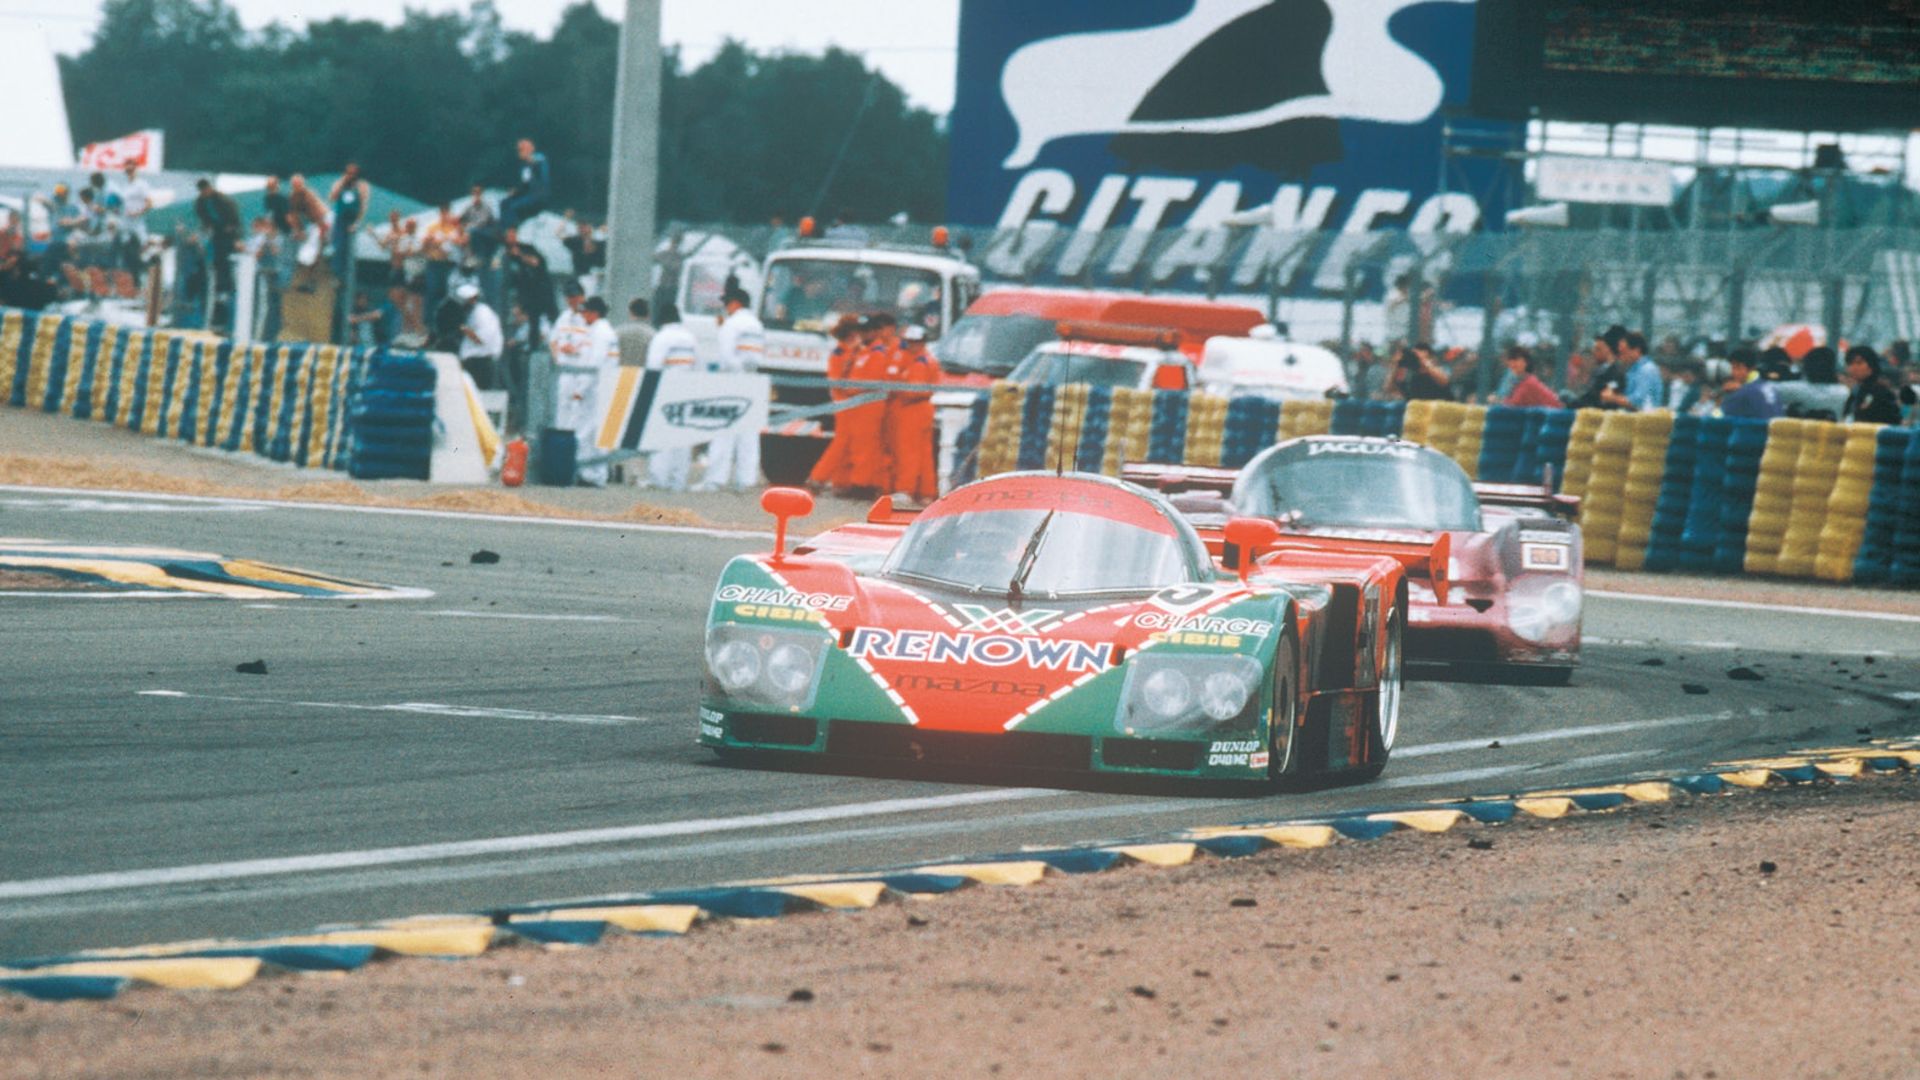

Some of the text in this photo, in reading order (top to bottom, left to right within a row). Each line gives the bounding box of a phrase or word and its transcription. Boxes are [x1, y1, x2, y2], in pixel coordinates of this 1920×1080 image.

[985, 168, 1480, 290] GITANES
[1307, 442, 1419, 460] JAGUAR
[716, 584, 855, 612] CHARGE
[1134, 611, 1274, 639] CHARGE
[848, 626, 1114, 674] RENOWN
[1209, 740, 1261, 753] DUNLOP
